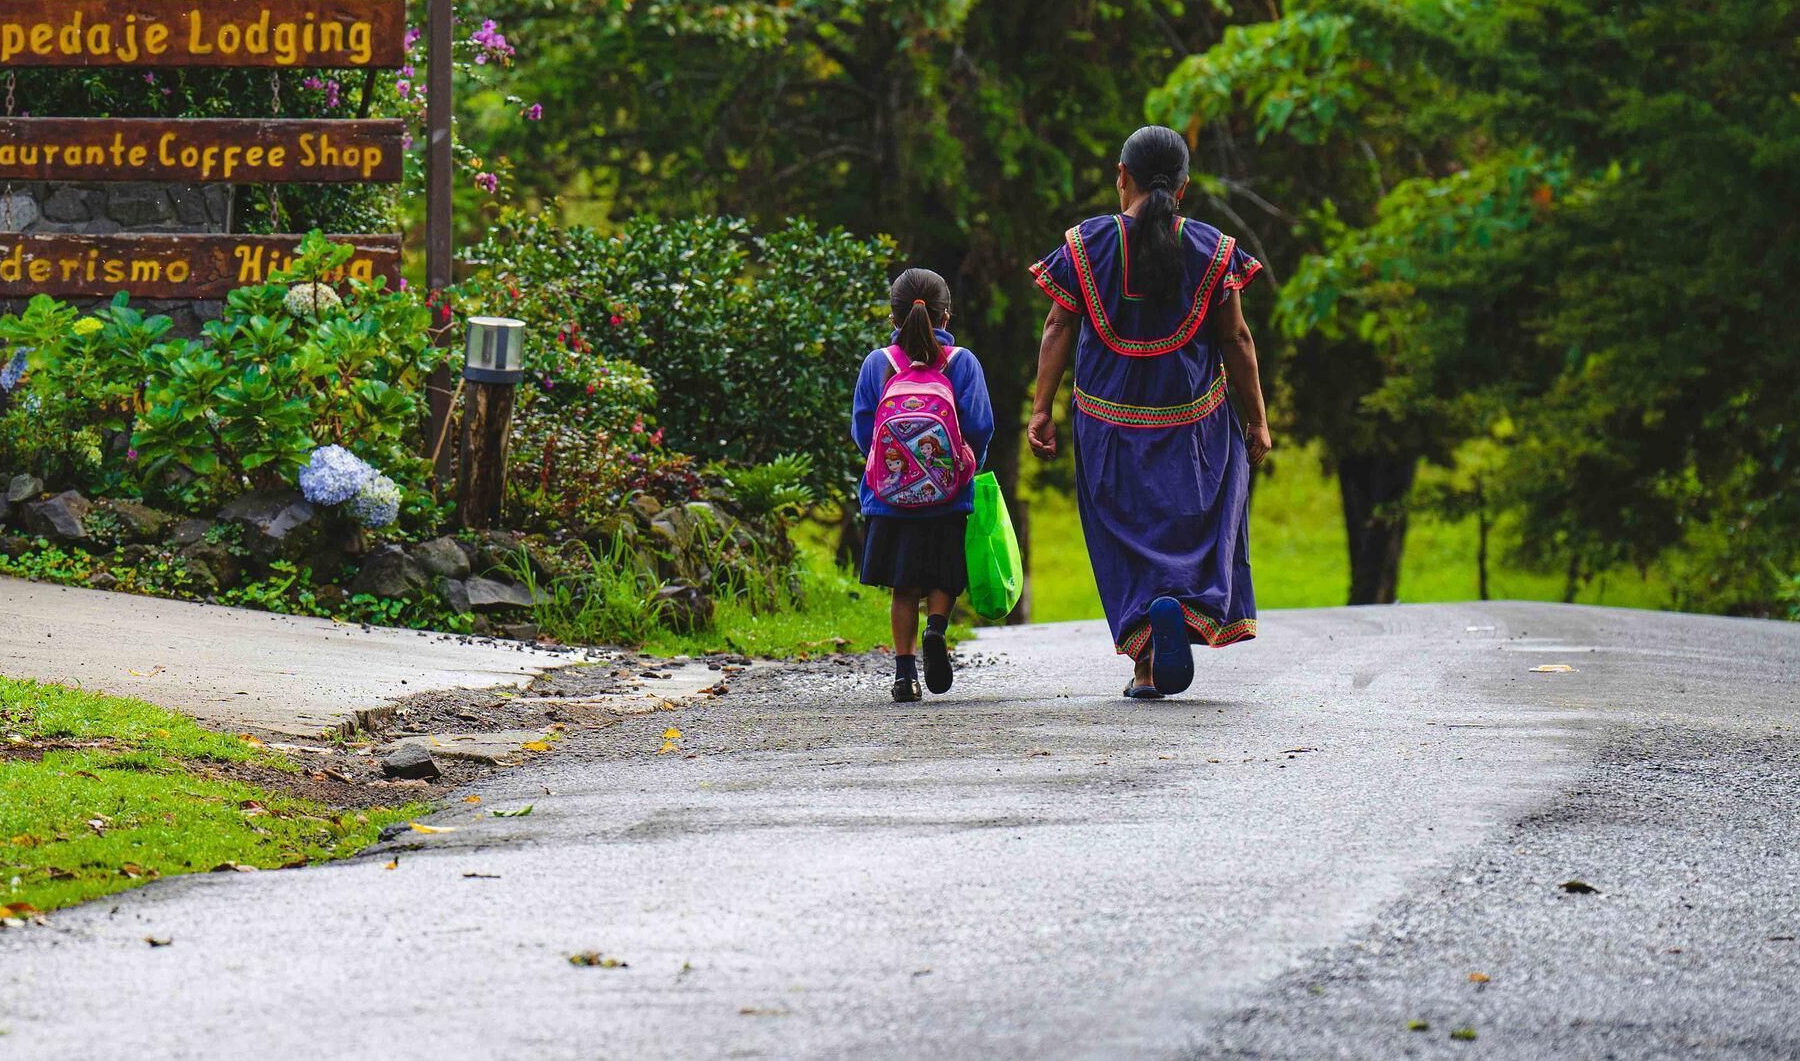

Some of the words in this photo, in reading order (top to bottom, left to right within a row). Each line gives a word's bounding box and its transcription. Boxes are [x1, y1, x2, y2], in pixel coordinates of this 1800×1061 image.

[188, 9, 373, 65] Lodging
[158, 134, 286, 178] Coffee
[299, 132, 384, 177] Shop
